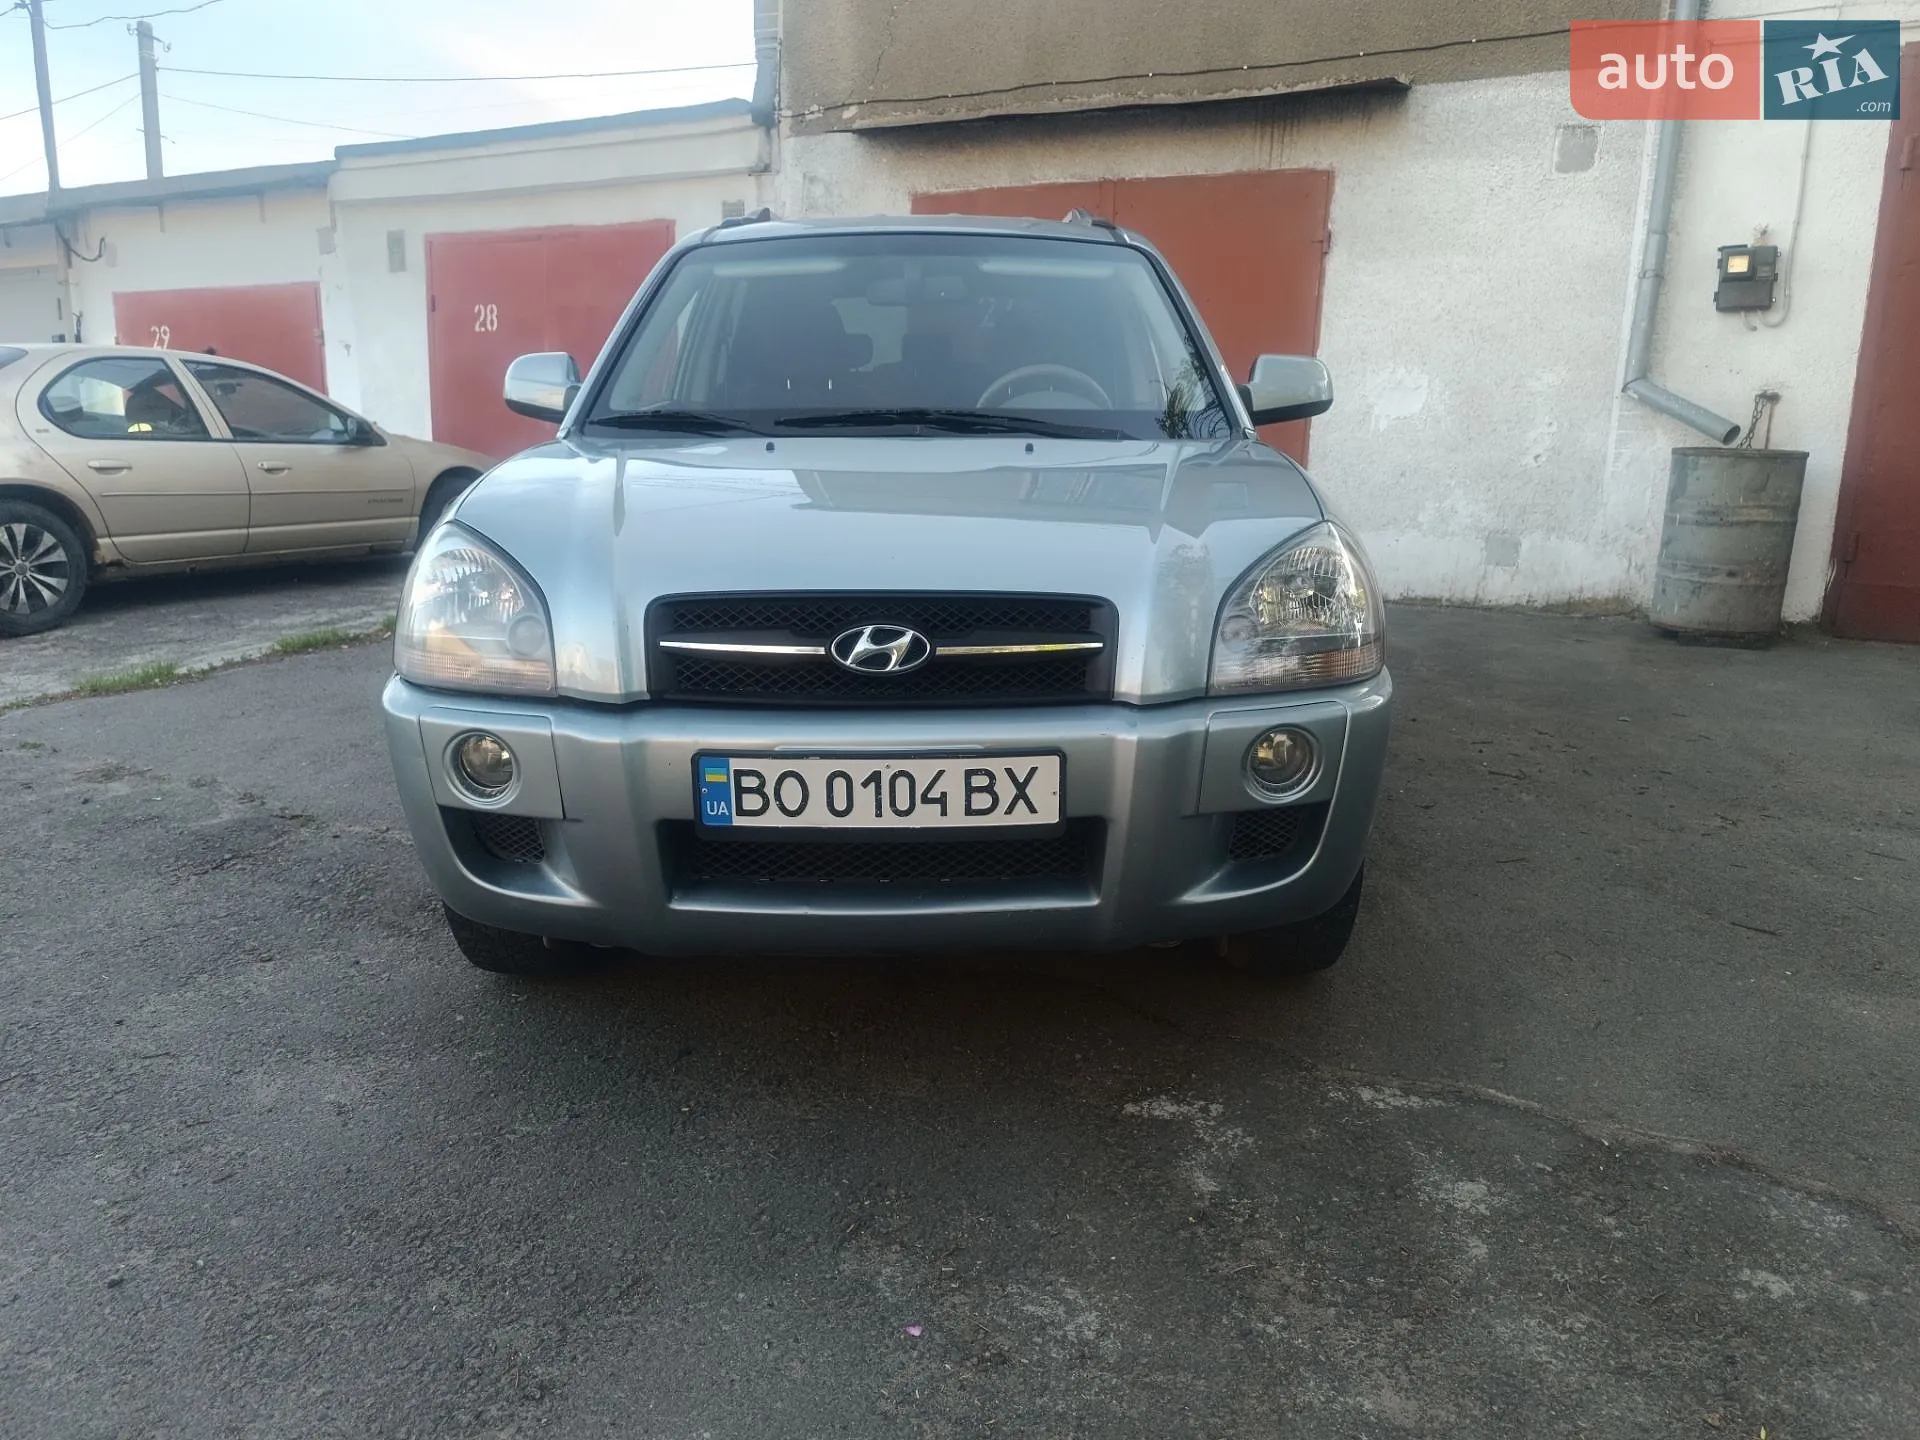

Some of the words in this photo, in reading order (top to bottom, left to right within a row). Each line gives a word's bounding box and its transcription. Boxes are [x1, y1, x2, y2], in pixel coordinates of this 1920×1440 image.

[474, 303, 498, 332] 28
[150, 325, 170, 350] 29
[733, 768, 809, 818] BO
[825, 768, 948, 818] 0104
[964, 766, 1039, 817] BX
[705, 800, 729, 816] UA
